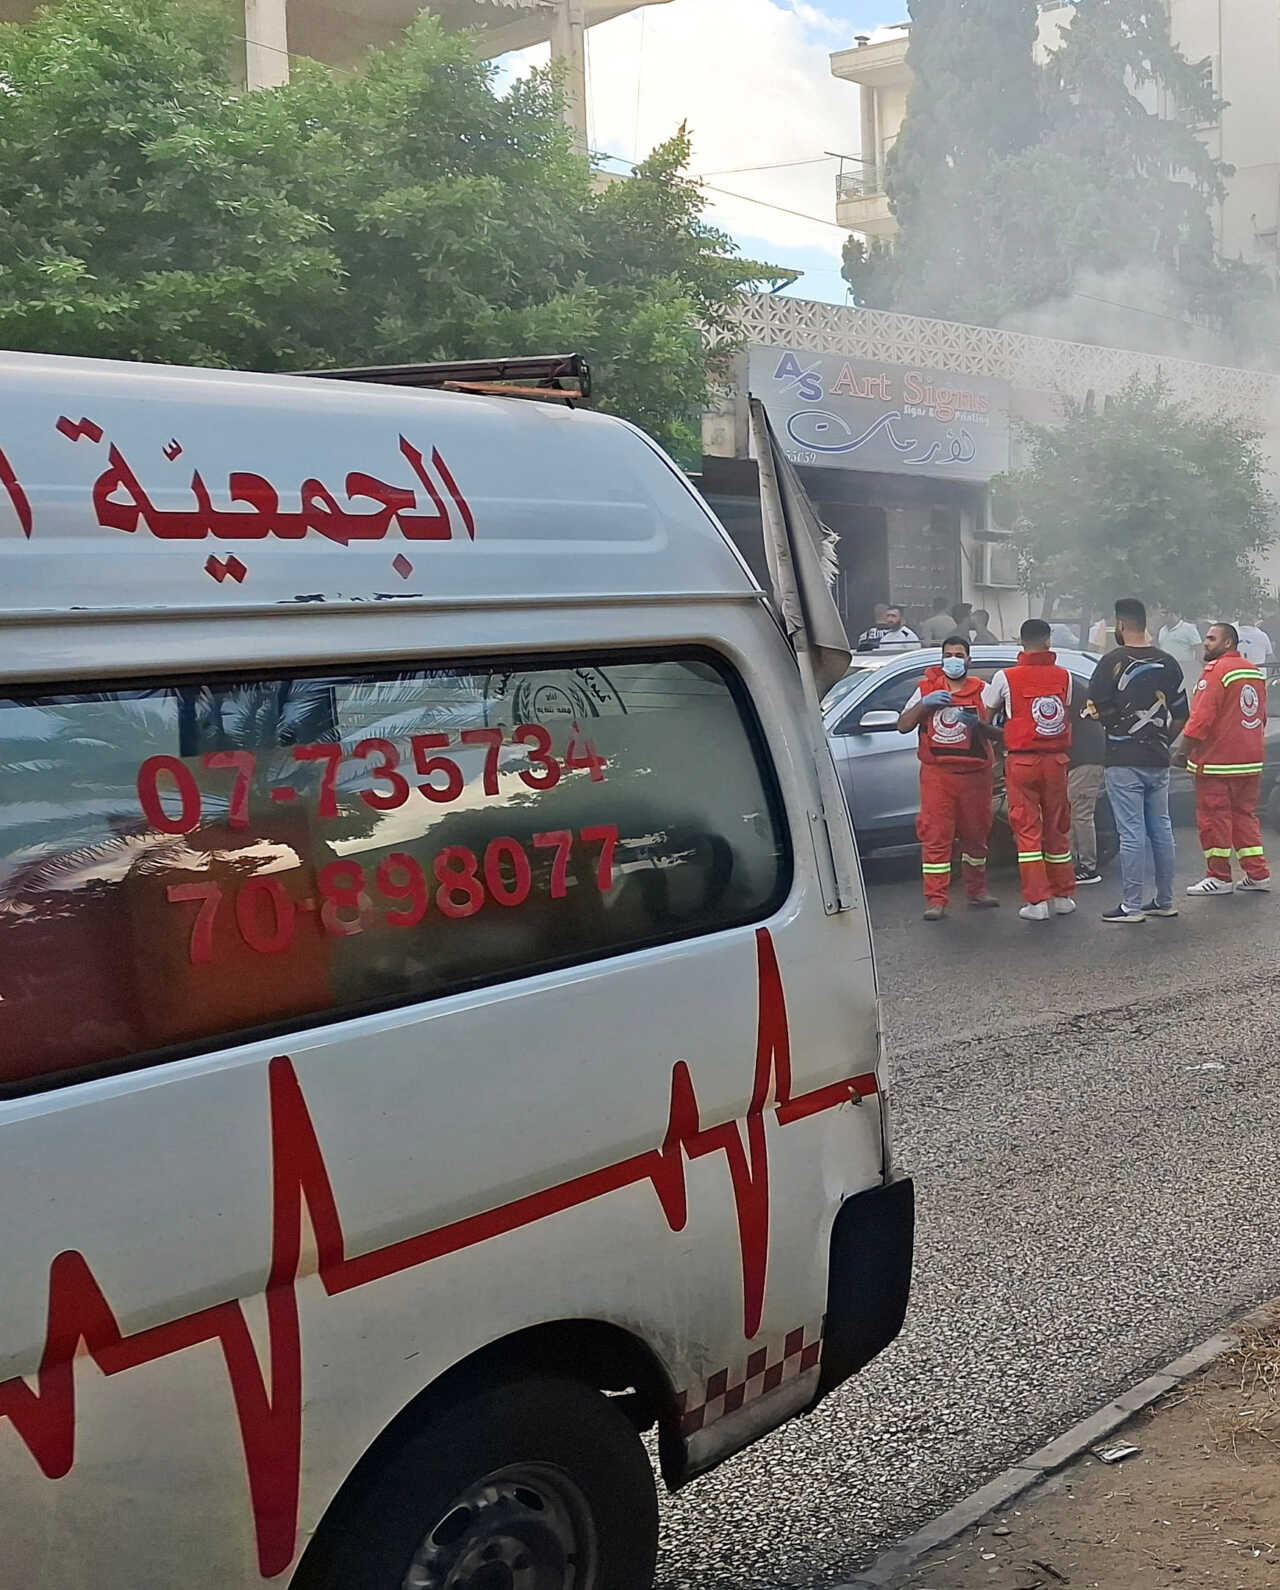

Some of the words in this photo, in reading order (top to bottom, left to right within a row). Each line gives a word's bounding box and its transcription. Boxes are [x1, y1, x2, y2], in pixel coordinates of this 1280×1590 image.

[830, 361, 892, 400] Art
[904, 371, 993, 423] Signs
[136, 722, 608, 835] 07-735734
[167, 824, 620, 965] 70-898077
